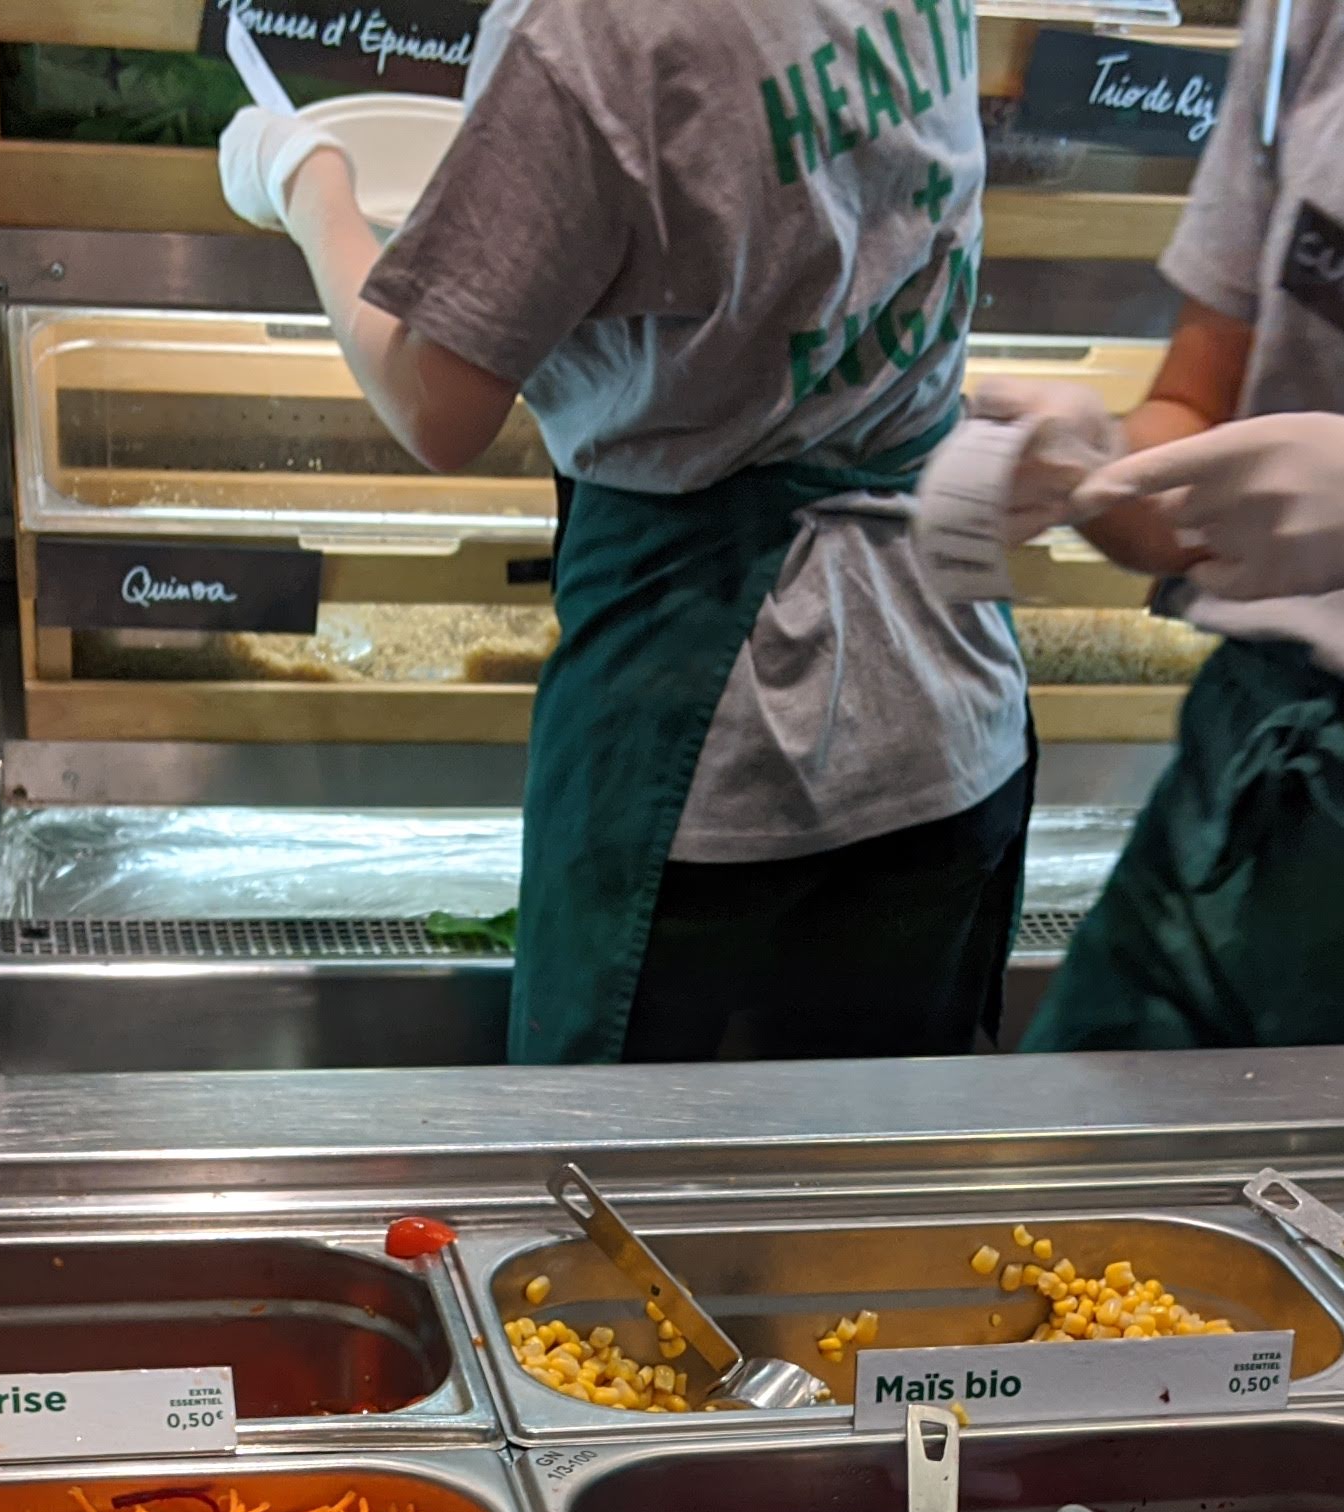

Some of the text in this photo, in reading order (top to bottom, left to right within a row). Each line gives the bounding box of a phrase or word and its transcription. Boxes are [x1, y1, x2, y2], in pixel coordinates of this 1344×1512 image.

[120, 565, 237, 607] Quinoa
[1252, 1352, 1281, 1361] EXTRA
[1233, 1362, 1281, 1372] ESSENTIEL
[188, 1387, 222, 1397] EXTRA
[875, 1370, 1022, 1404] Maïs bio
[1229, 1374, 1280, 1395] 0,50€
[169, 1397, 223, 1407] ESSENTIEL
[166, 1410, 224, 1430] 0,50€
